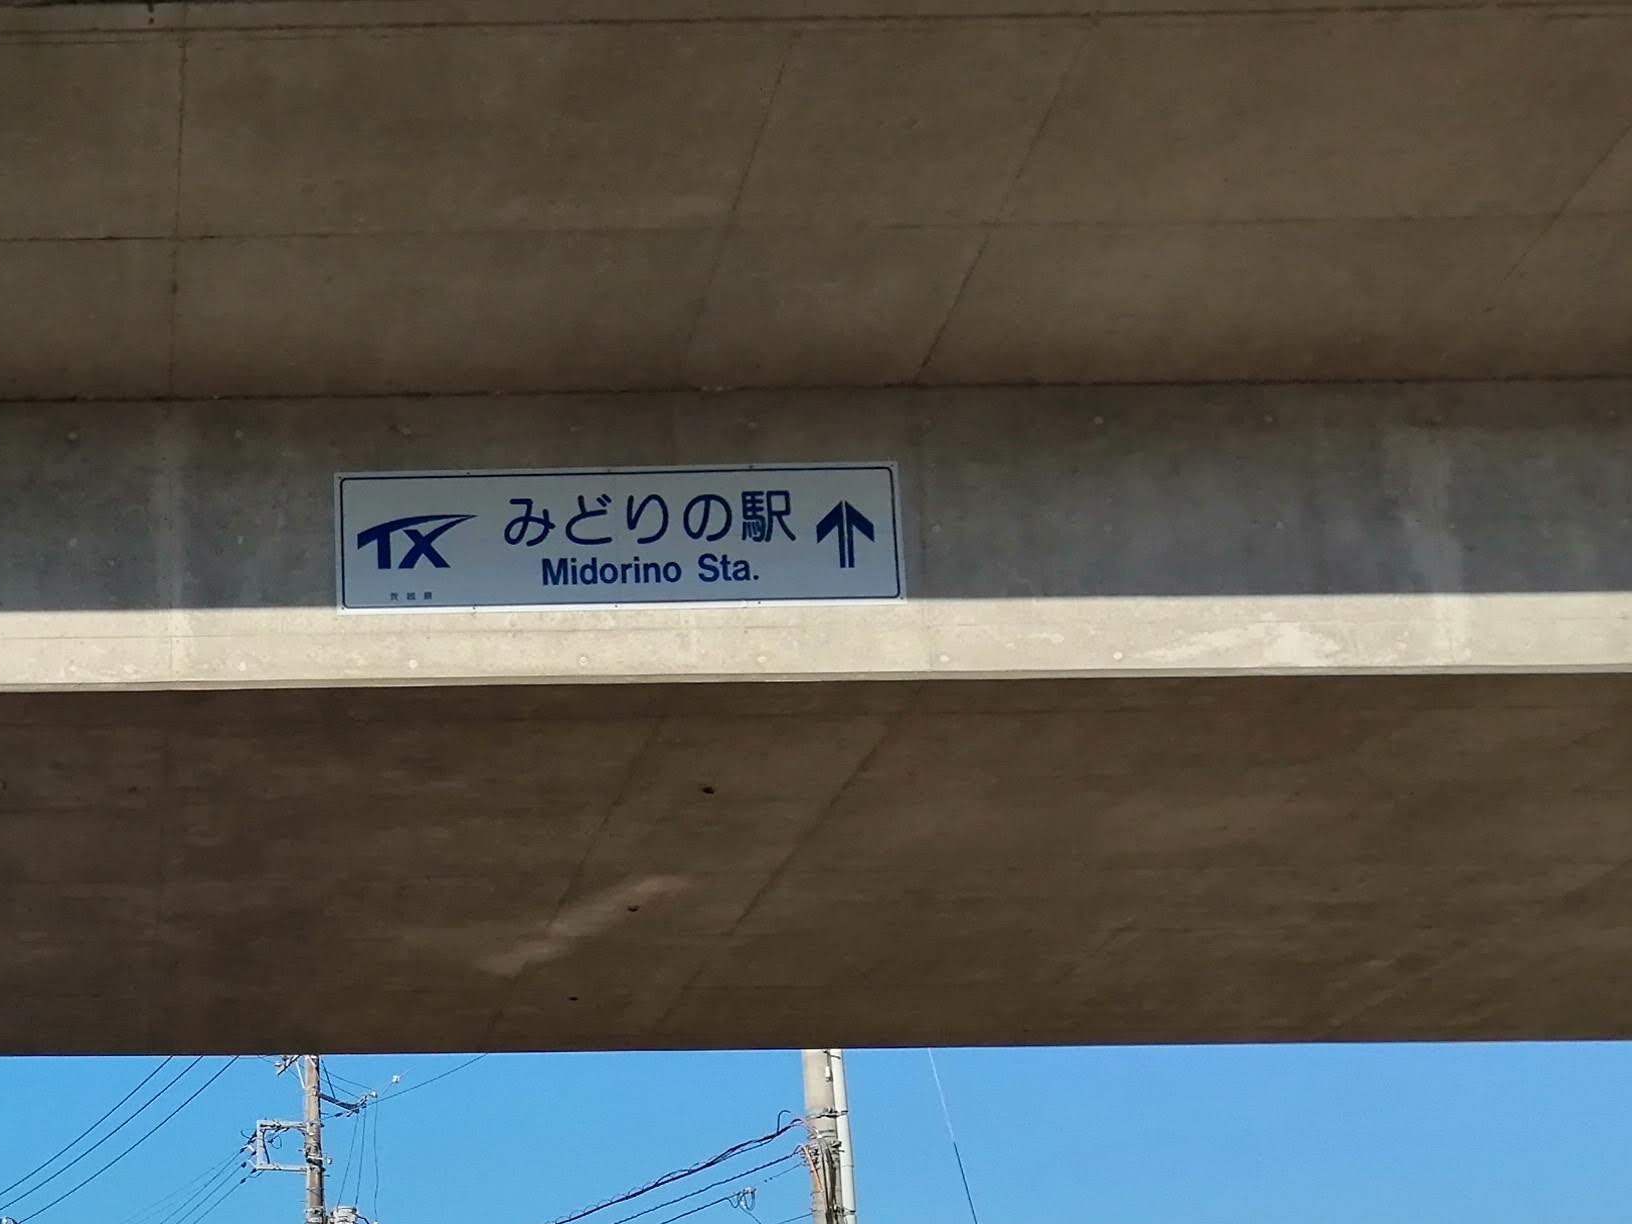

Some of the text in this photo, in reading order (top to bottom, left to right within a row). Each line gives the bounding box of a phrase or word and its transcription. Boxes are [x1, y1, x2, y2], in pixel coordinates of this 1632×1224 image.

[357, 514, 479, 570] TX
[504, 490, 798, 546] みどりの駅
[541, 553, 760, 587] Midorino Sta.
